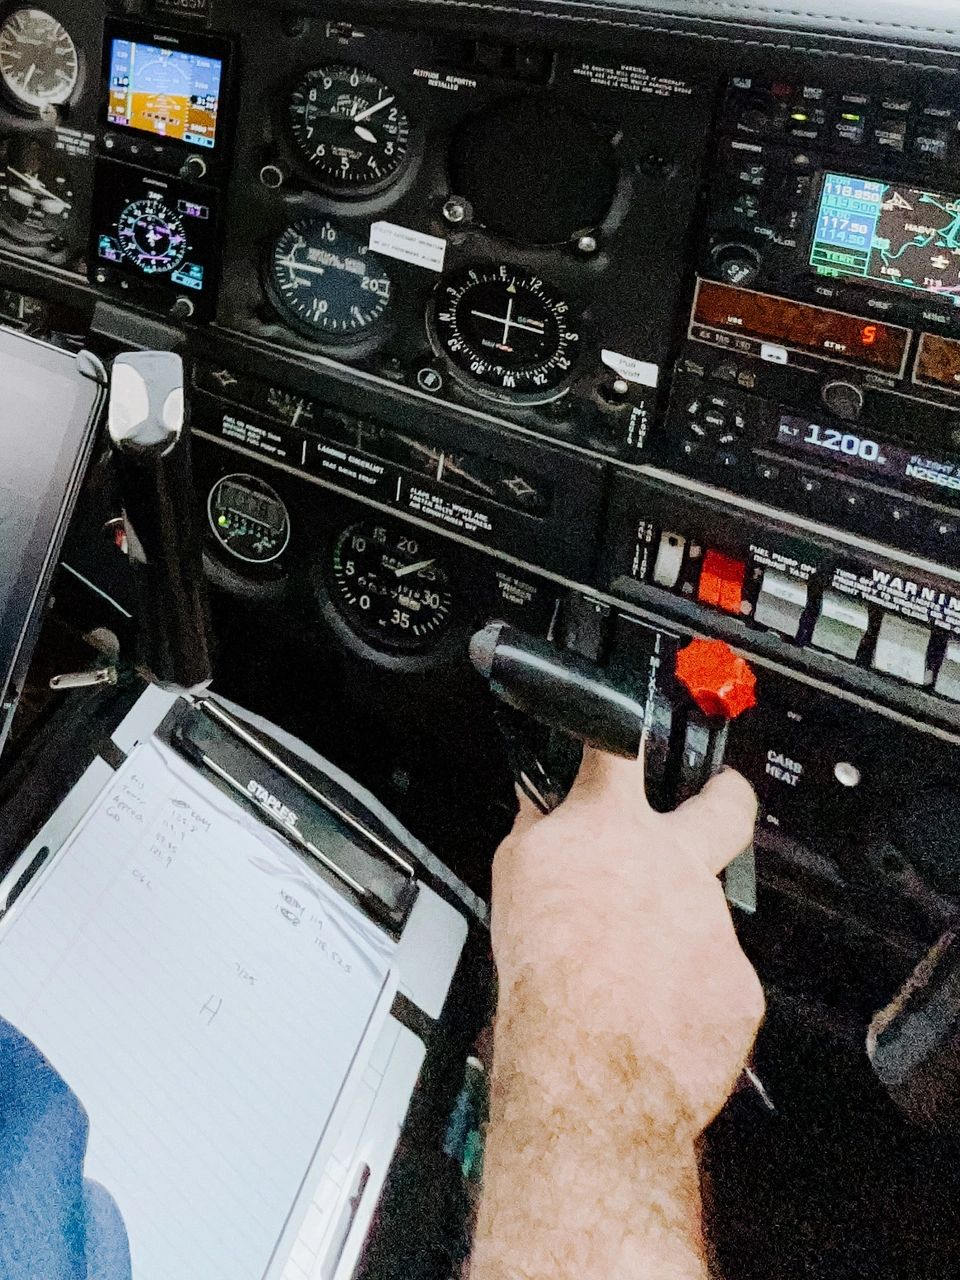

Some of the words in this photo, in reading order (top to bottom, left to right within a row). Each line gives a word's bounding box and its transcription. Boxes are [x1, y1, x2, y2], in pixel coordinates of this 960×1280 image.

[323, 77, 332, 90] 9
[349, 73, 359, 87] 0
[309, 89, 317, 101] 8
[388, 107, 398, 122] 2
[306, 126, 314, 139] 7
[316, 144, 326, 156] 6
[384, 141, 394, 155] 3
[340, 157, 350, 170] 5
[499, 265, 508, 277] E
[361, 276, 379, 293] 20
[530, 275, 543, 288] 12
[312, 297, 328, 314] 10
[555, 301, 569, 313] 15
[438, 312, 451, 322] N
[565, 332, 579, 342] S
[502, 375, 516, 388] W
[803, 423, 879, 462] 1200
[351, 536, 366, 553] 10
[397, 536, 419, 555] 20
[749, 544, 770, 558] FUEL
[771, 552, 798, 567] PUMP
[345, 560, 356, 576] 5
[359, 594, 371, 611] 0
[420, 588, 440, 609] 30
[390, 608, 411, 629] 35
[767, 749, 803, 774] CARB
[765, 763, 800, 787] HEAT
[247, 780, 299, 827] STAPLES
